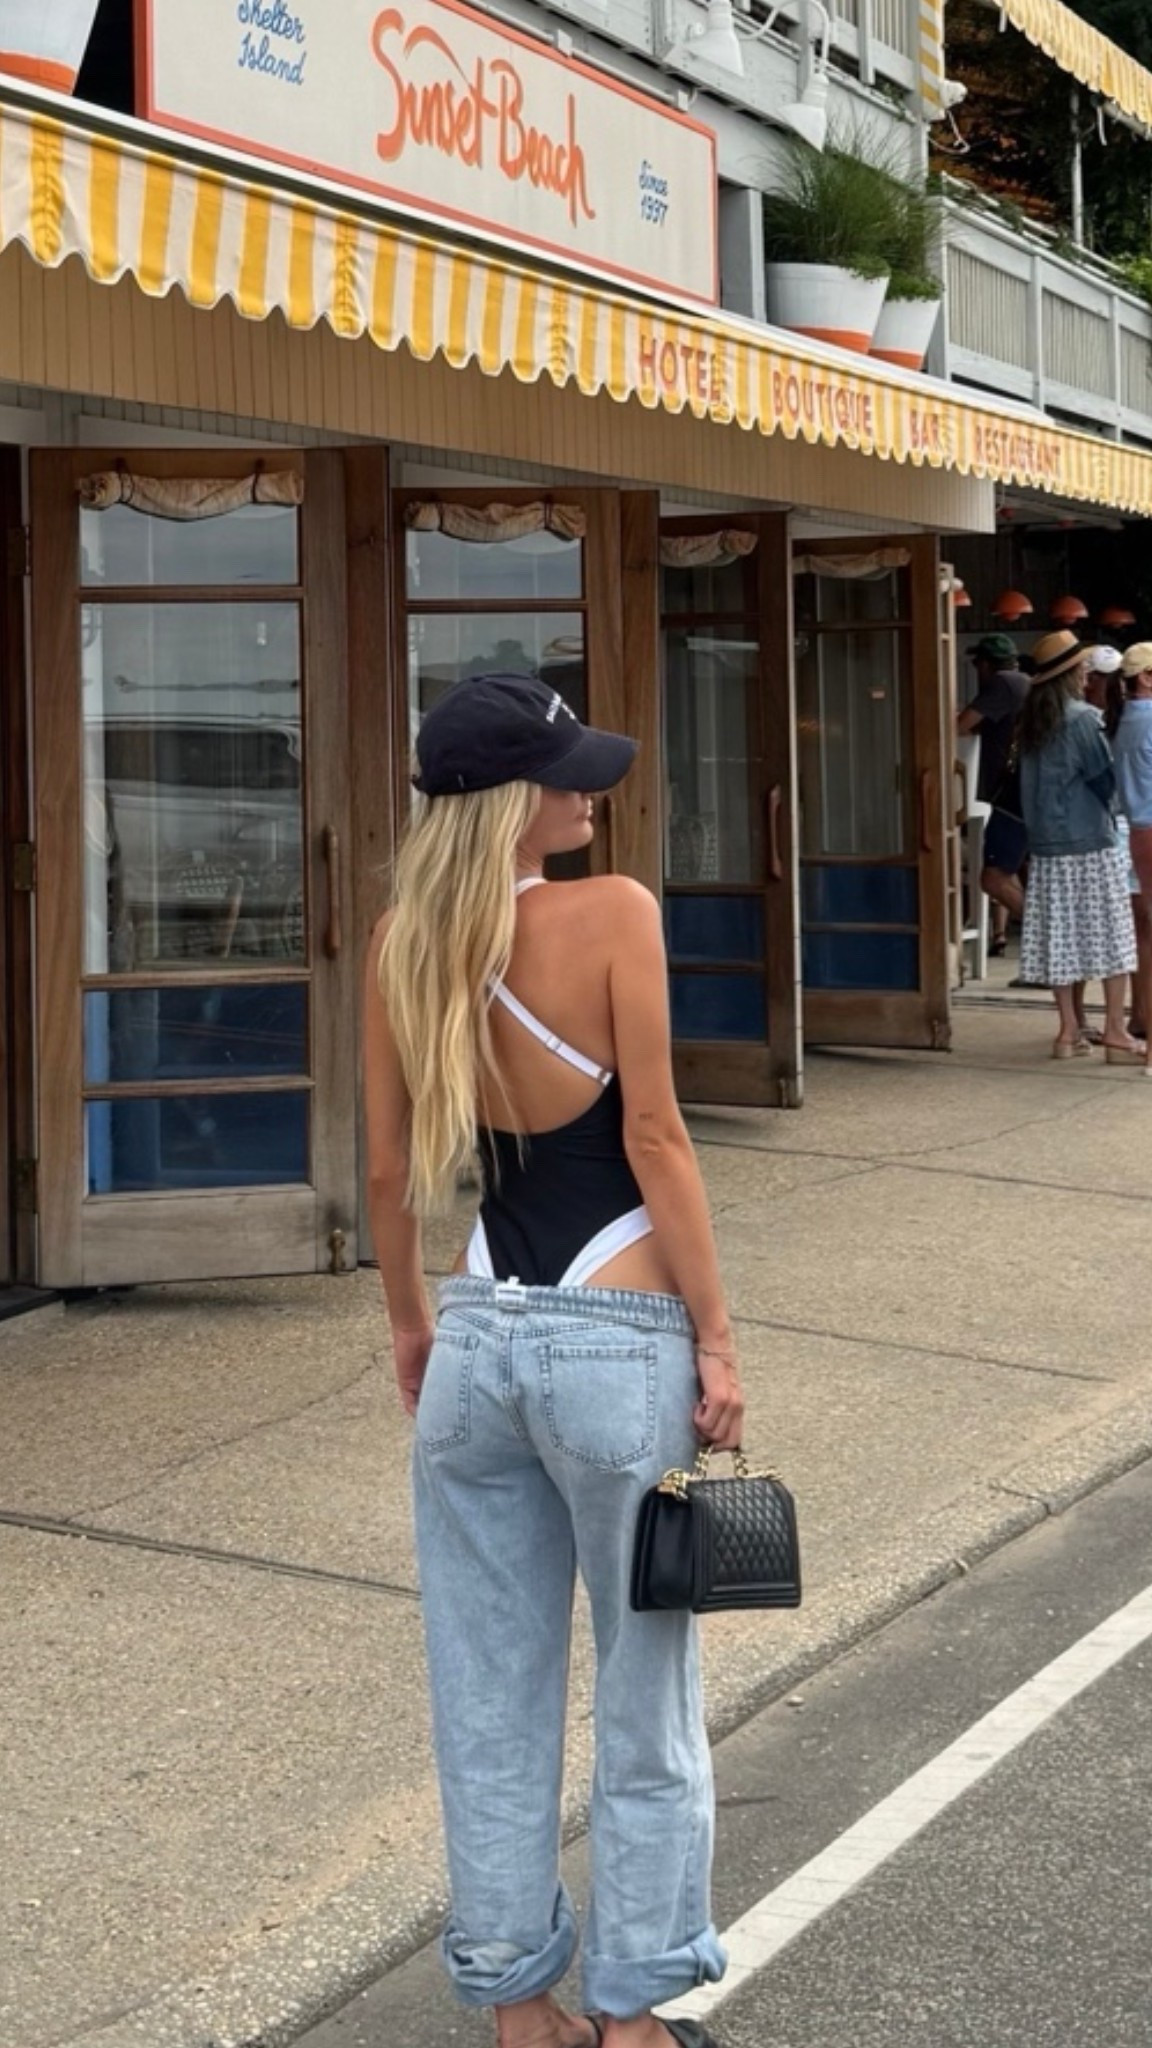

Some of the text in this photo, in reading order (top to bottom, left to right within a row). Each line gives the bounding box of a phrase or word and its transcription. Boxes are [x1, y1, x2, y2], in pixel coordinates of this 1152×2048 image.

[237, 31, 307, 86] Island
[490, 58, 596, 228] Beach
[638, 334, 721, 401] HOTEL
[772, 369, 872, 437] BOUTIQUE
[909, 408, 941, 450] BAR
